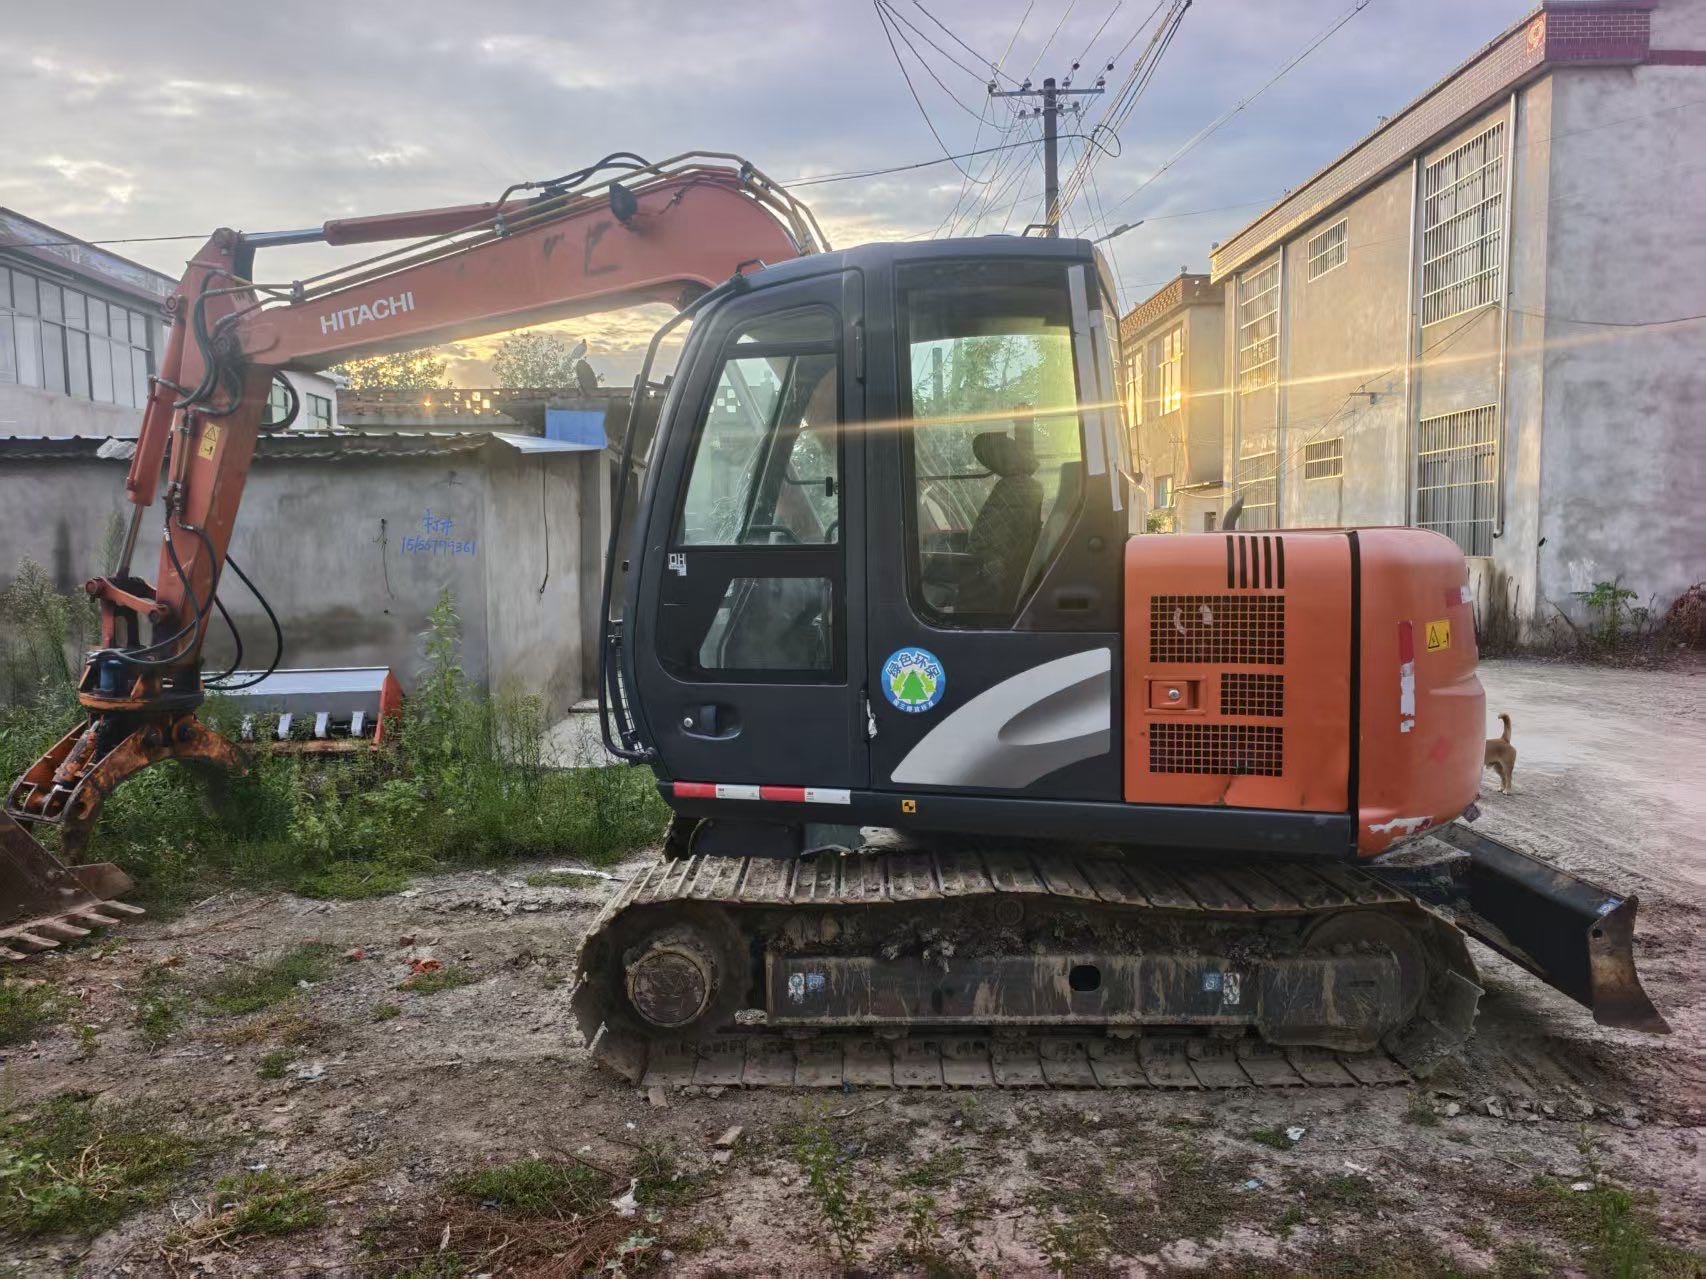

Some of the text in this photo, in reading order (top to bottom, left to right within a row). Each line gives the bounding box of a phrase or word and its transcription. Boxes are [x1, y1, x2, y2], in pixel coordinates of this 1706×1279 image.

[320, 292, 415, 334] HITACHI
[886, 652, 941, 679] 绿色环保
